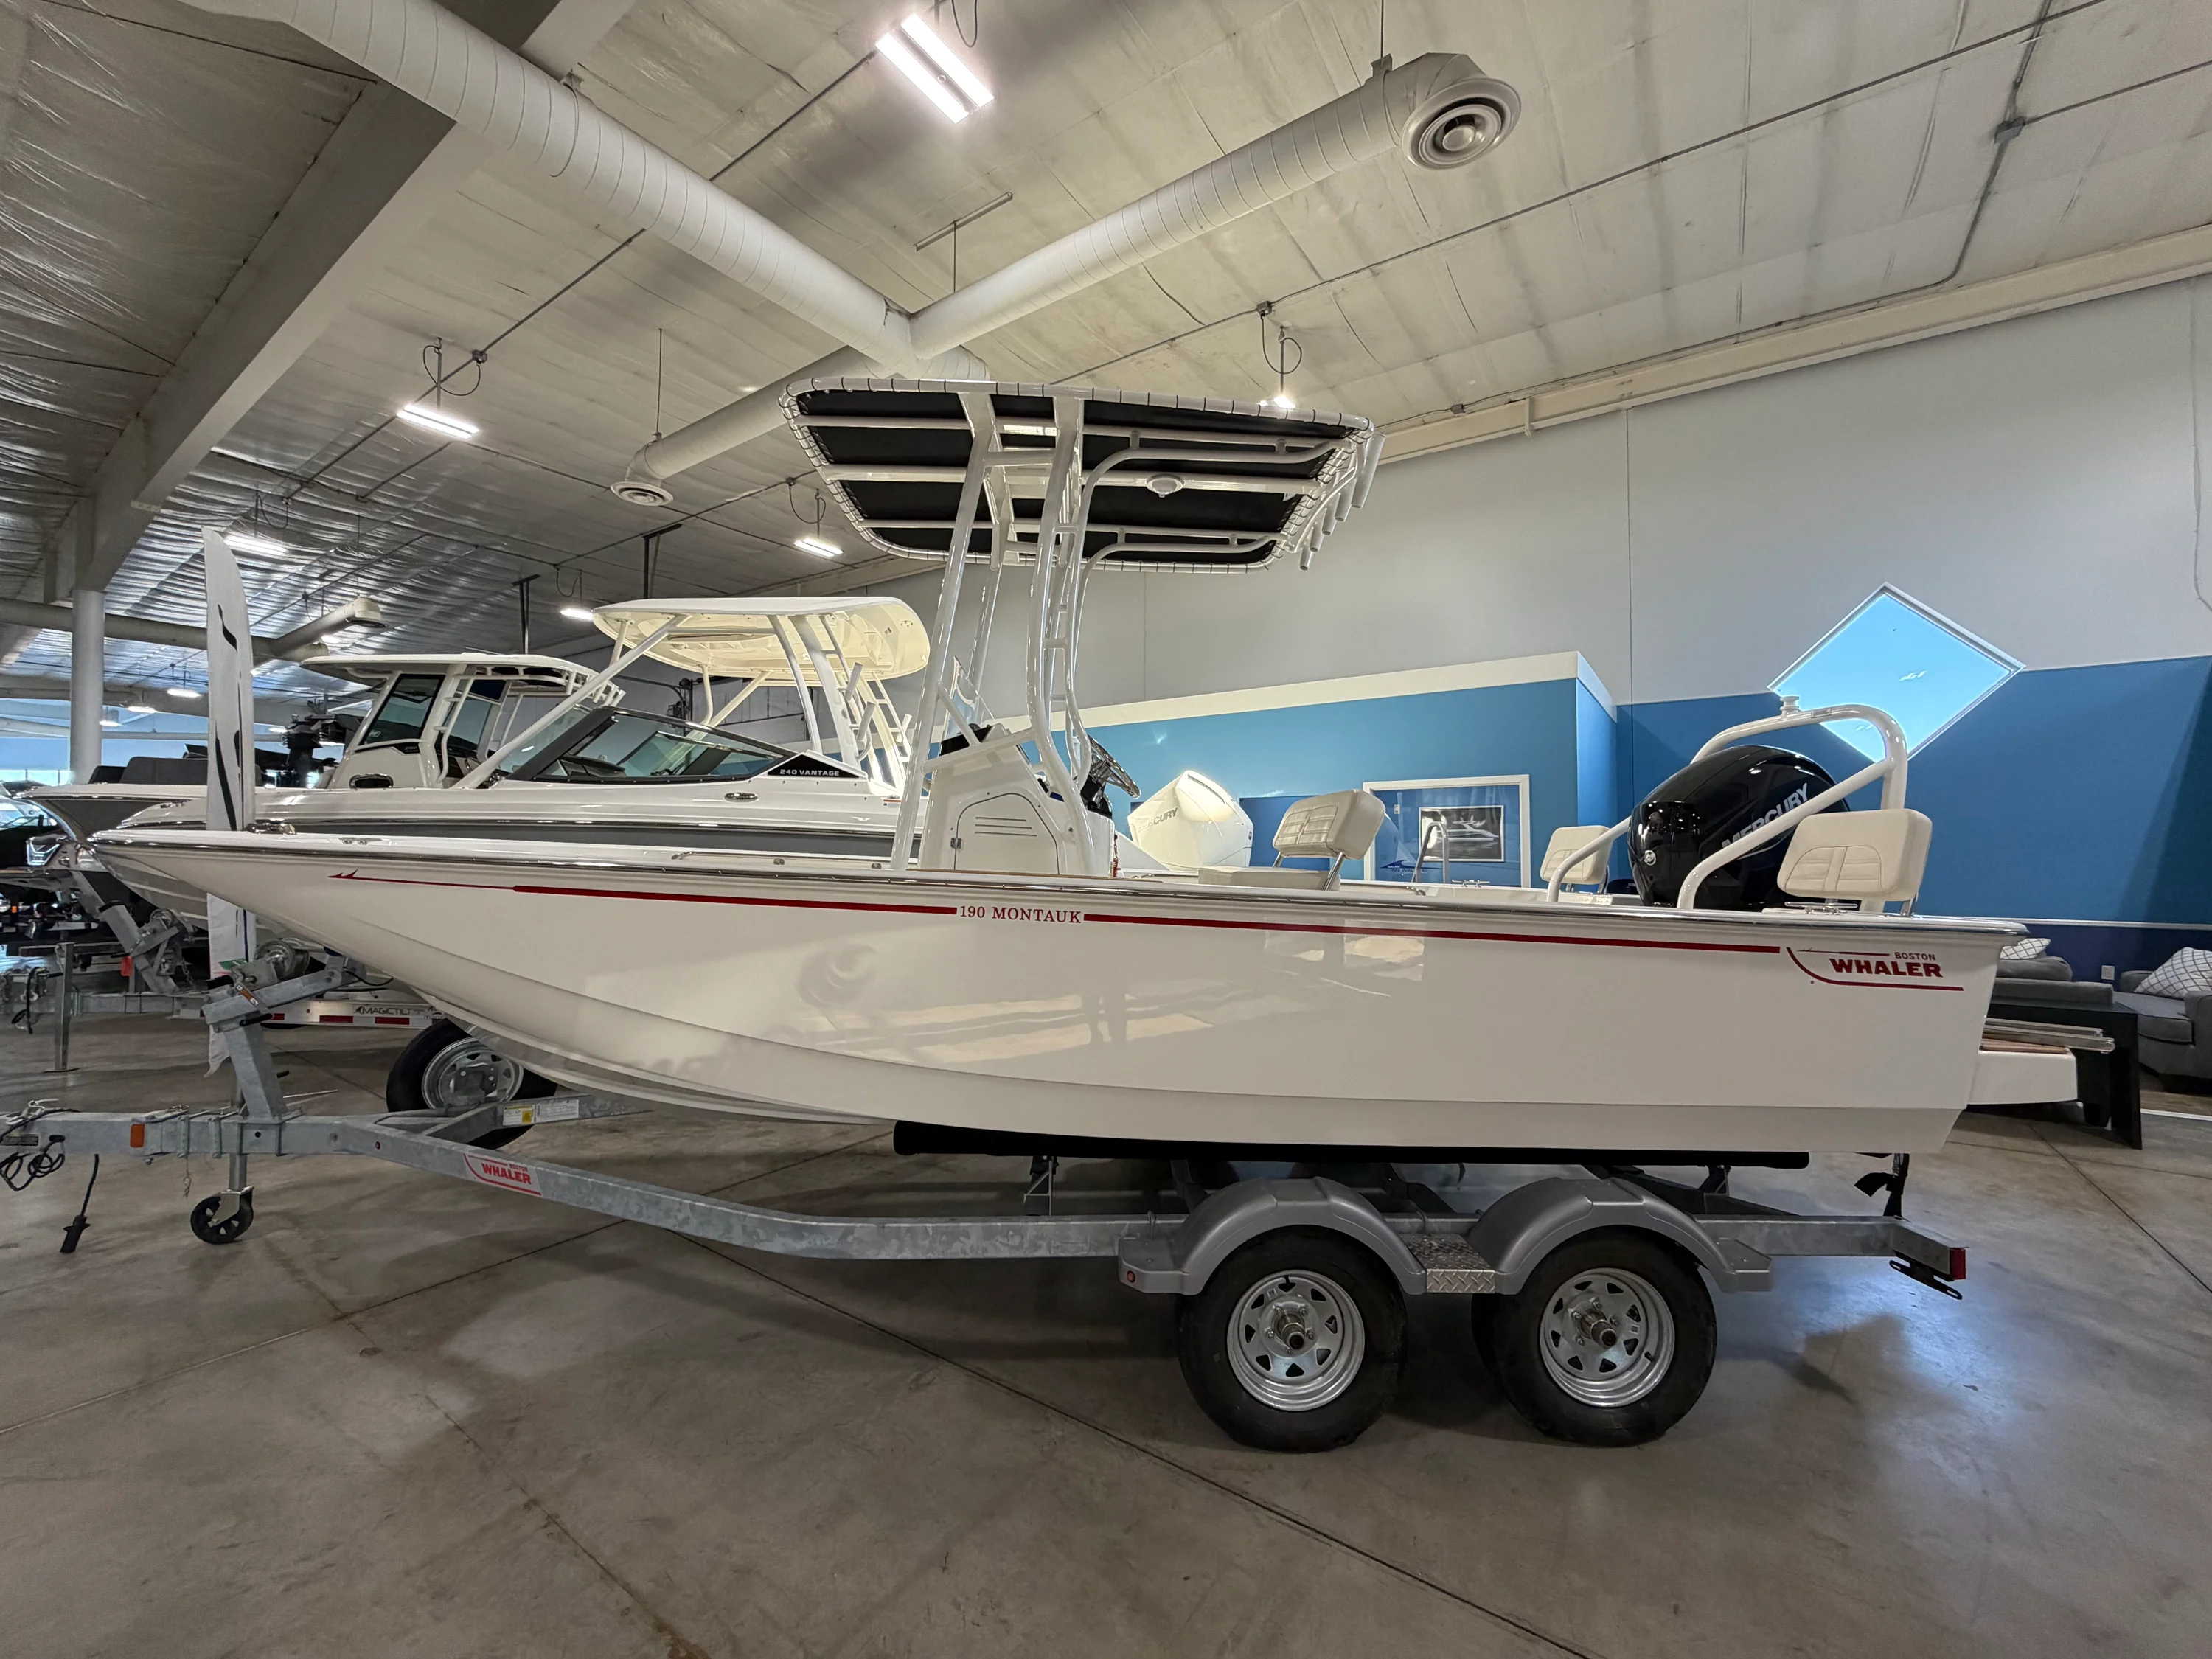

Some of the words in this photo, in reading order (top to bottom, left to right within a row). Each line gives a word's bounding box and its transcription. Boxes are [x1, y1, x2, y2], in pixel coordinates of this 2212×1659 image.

[960, 905, 986, 919] 190
[992, 906, 1082, 924] MONTAUK
[1894, 951, 1935, 961] BOSTON
[1829, 958, 1944, 978] WHALER
[362, 1005, 411, 1015] MAGICTILT
[481, 1162, 532, 1186] WHALER
